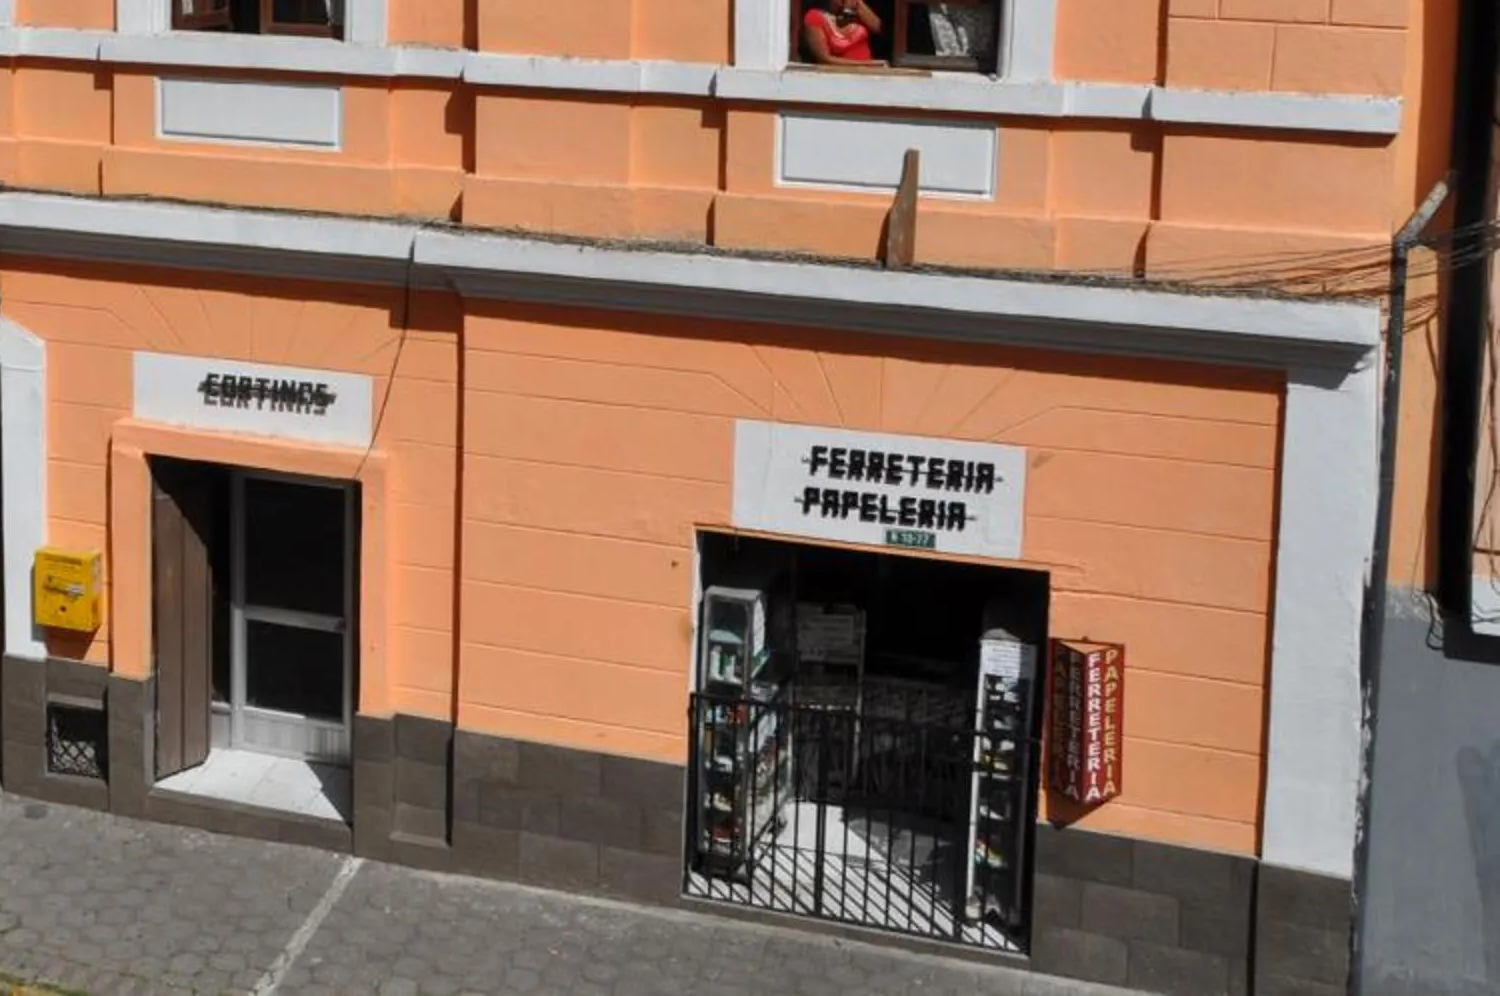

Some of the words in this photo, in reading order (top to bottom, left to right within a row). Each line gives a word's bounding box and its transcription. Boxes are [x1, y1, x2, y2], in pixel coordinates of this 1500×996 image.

[802, 487, 967, 531] PAPELERIA
[809, 445, 996, 494] FERRETERIA
[1085, 653, 1102, 801] FERRETERIA
[1104, 648, 1119, 795] PAPELERIA
